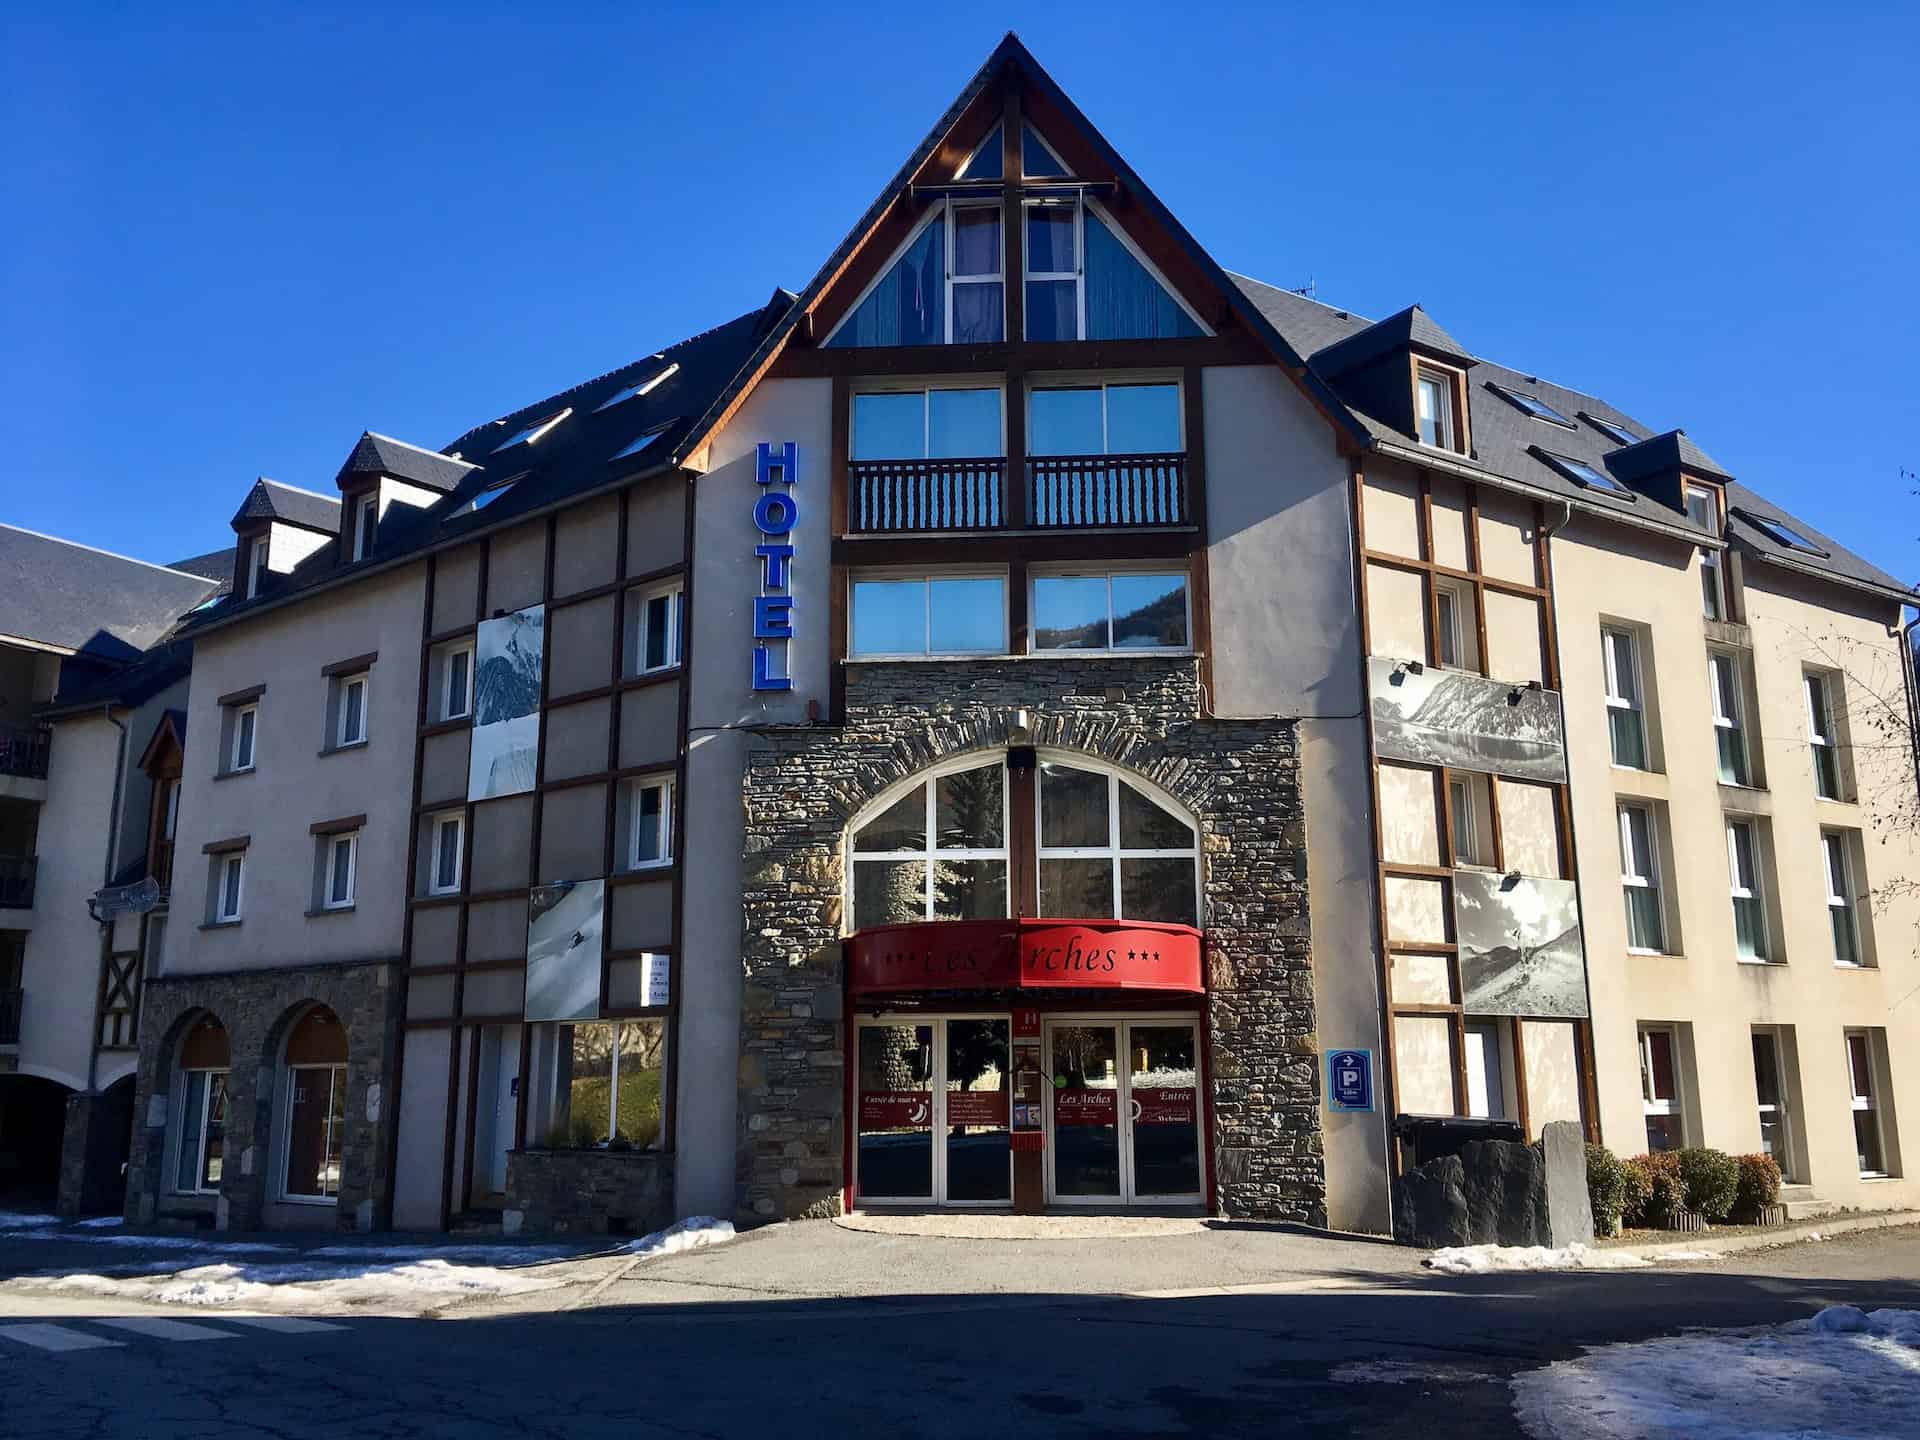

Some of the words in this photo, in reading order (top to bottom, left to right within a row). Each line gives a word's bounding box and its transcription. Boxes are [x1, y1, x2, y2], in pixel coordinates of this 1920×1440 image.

[752, 441, 799, 691] HOTEL
[1343, 1070, 1358, 1086] P
[1059, 1093, 1076, 1104] Les
[1077, 1092, 1112, 1105] Arches
